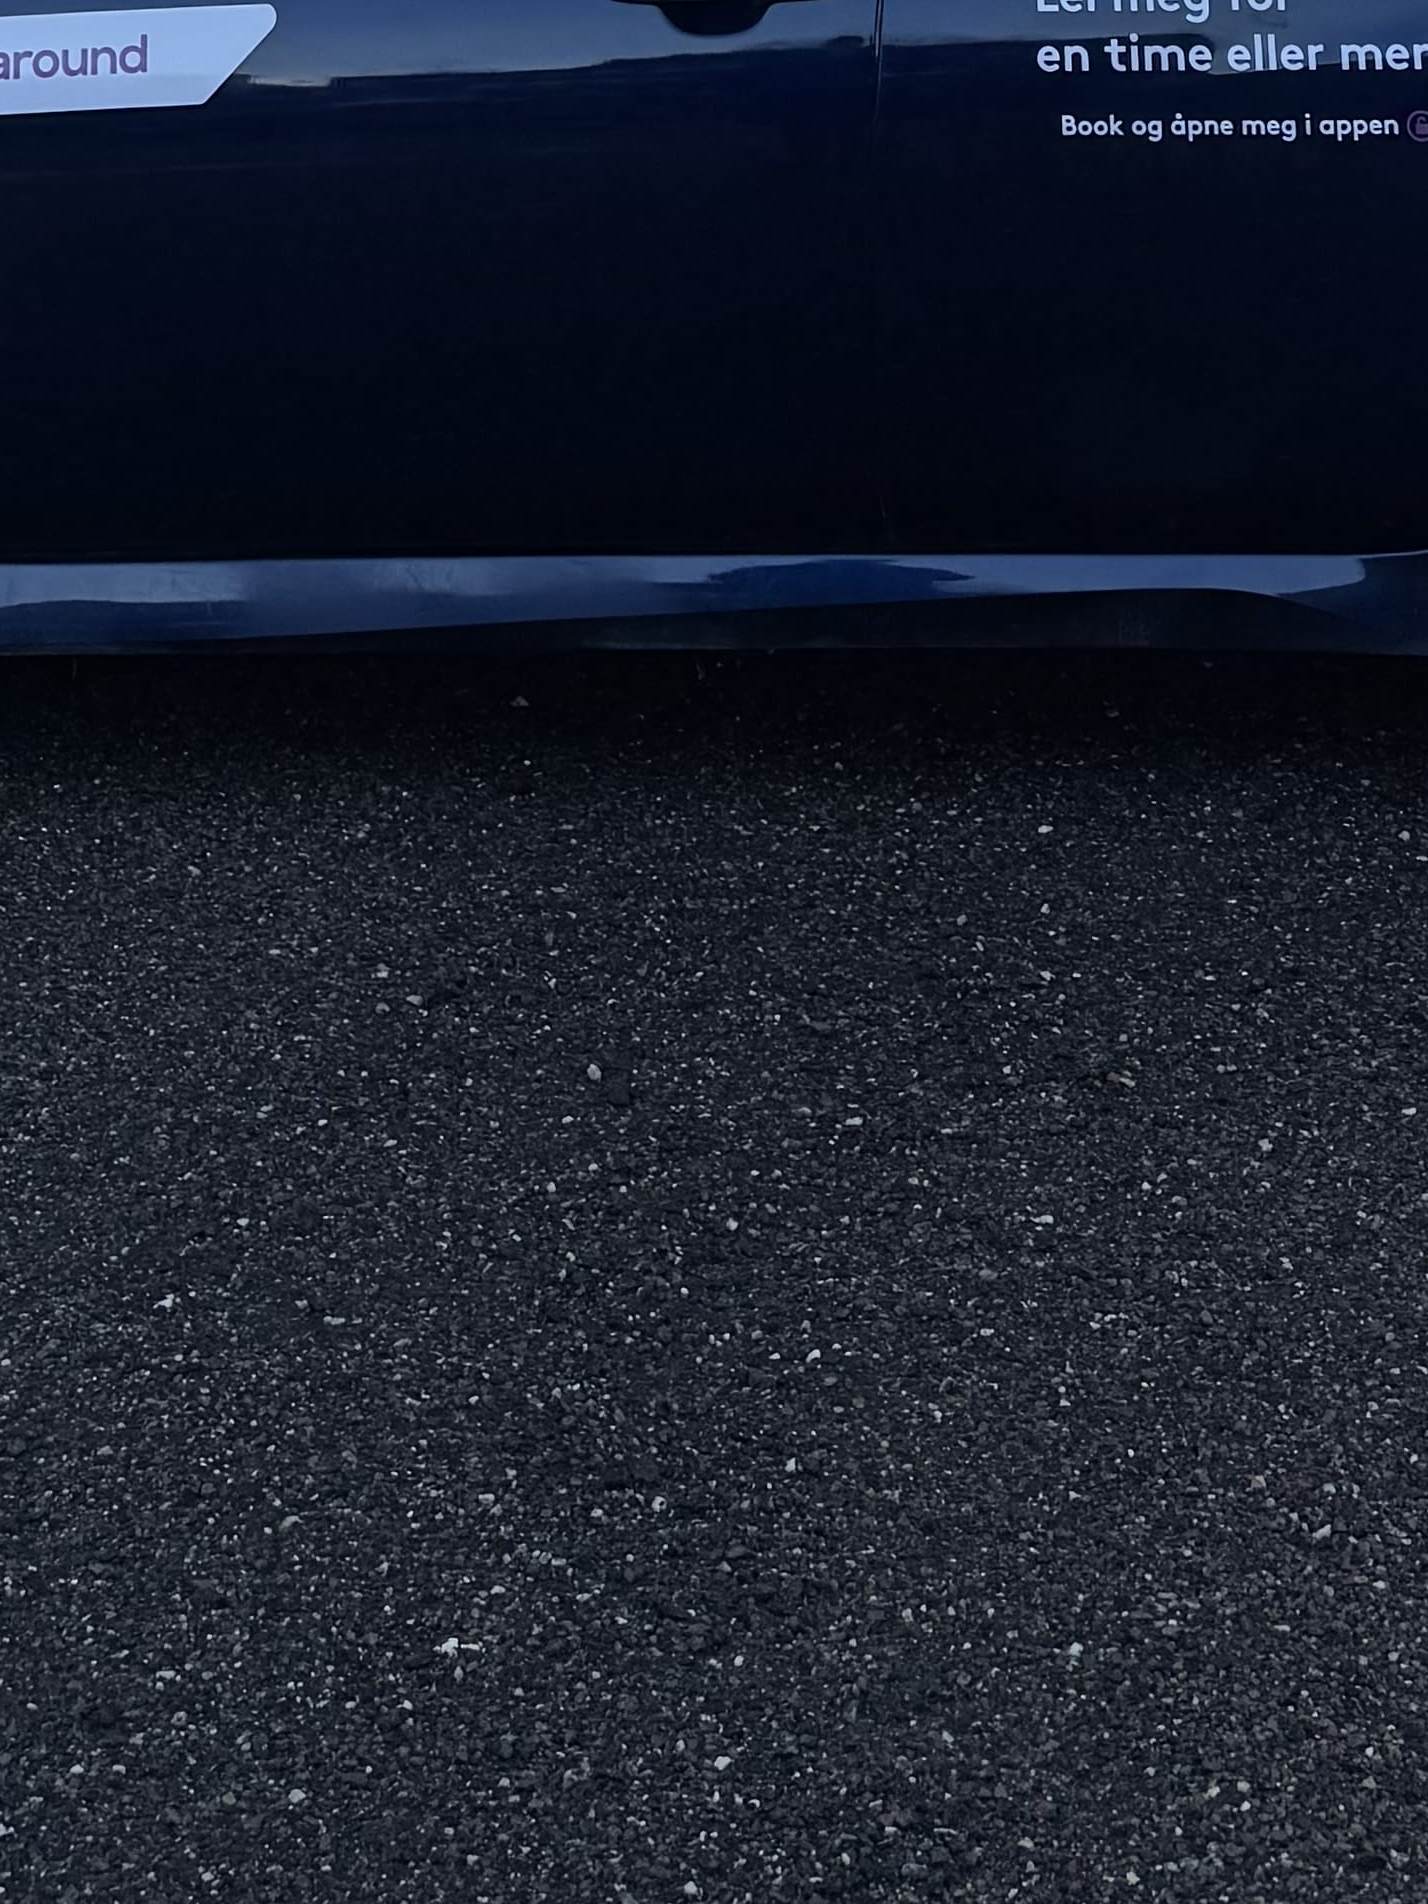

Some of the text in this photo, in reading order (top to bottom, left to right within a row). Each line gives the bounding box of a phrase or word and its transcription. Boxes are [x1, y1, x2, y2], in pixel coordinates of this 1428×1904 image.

[1036, 44, 1090, 72] en
[1104, 32, 1213, 72] time
[1227, 33, 1324, 72] eller
[1061, 112, 1400, 142] Book og åpne meg i appen
